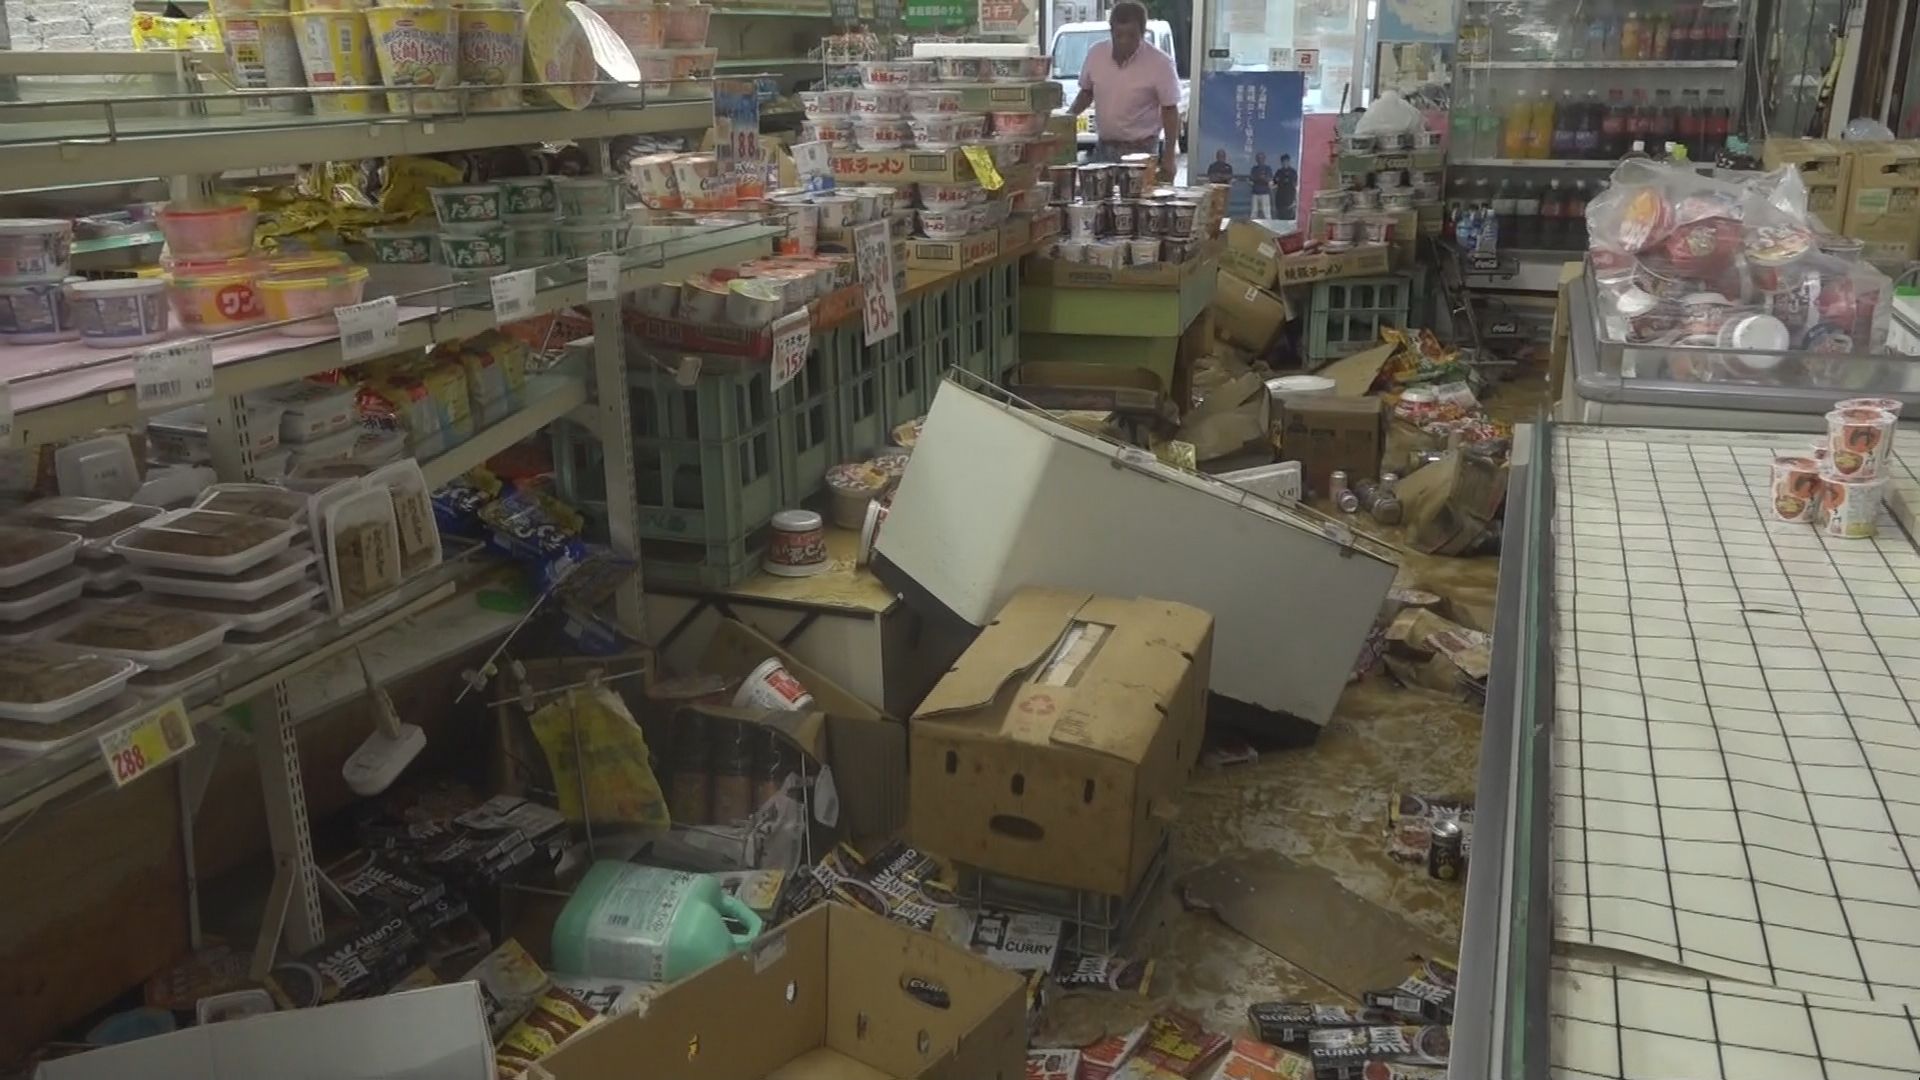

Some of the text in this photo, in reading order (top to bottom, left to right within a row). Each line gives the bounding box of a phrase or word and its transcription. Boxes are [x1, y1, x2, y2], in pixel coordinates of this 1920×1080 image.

[112, 744, 145, 780] 288
[1005, 940, 1053, 956] CURRY
[1312, 1048, 1369, 1057] CURRY
